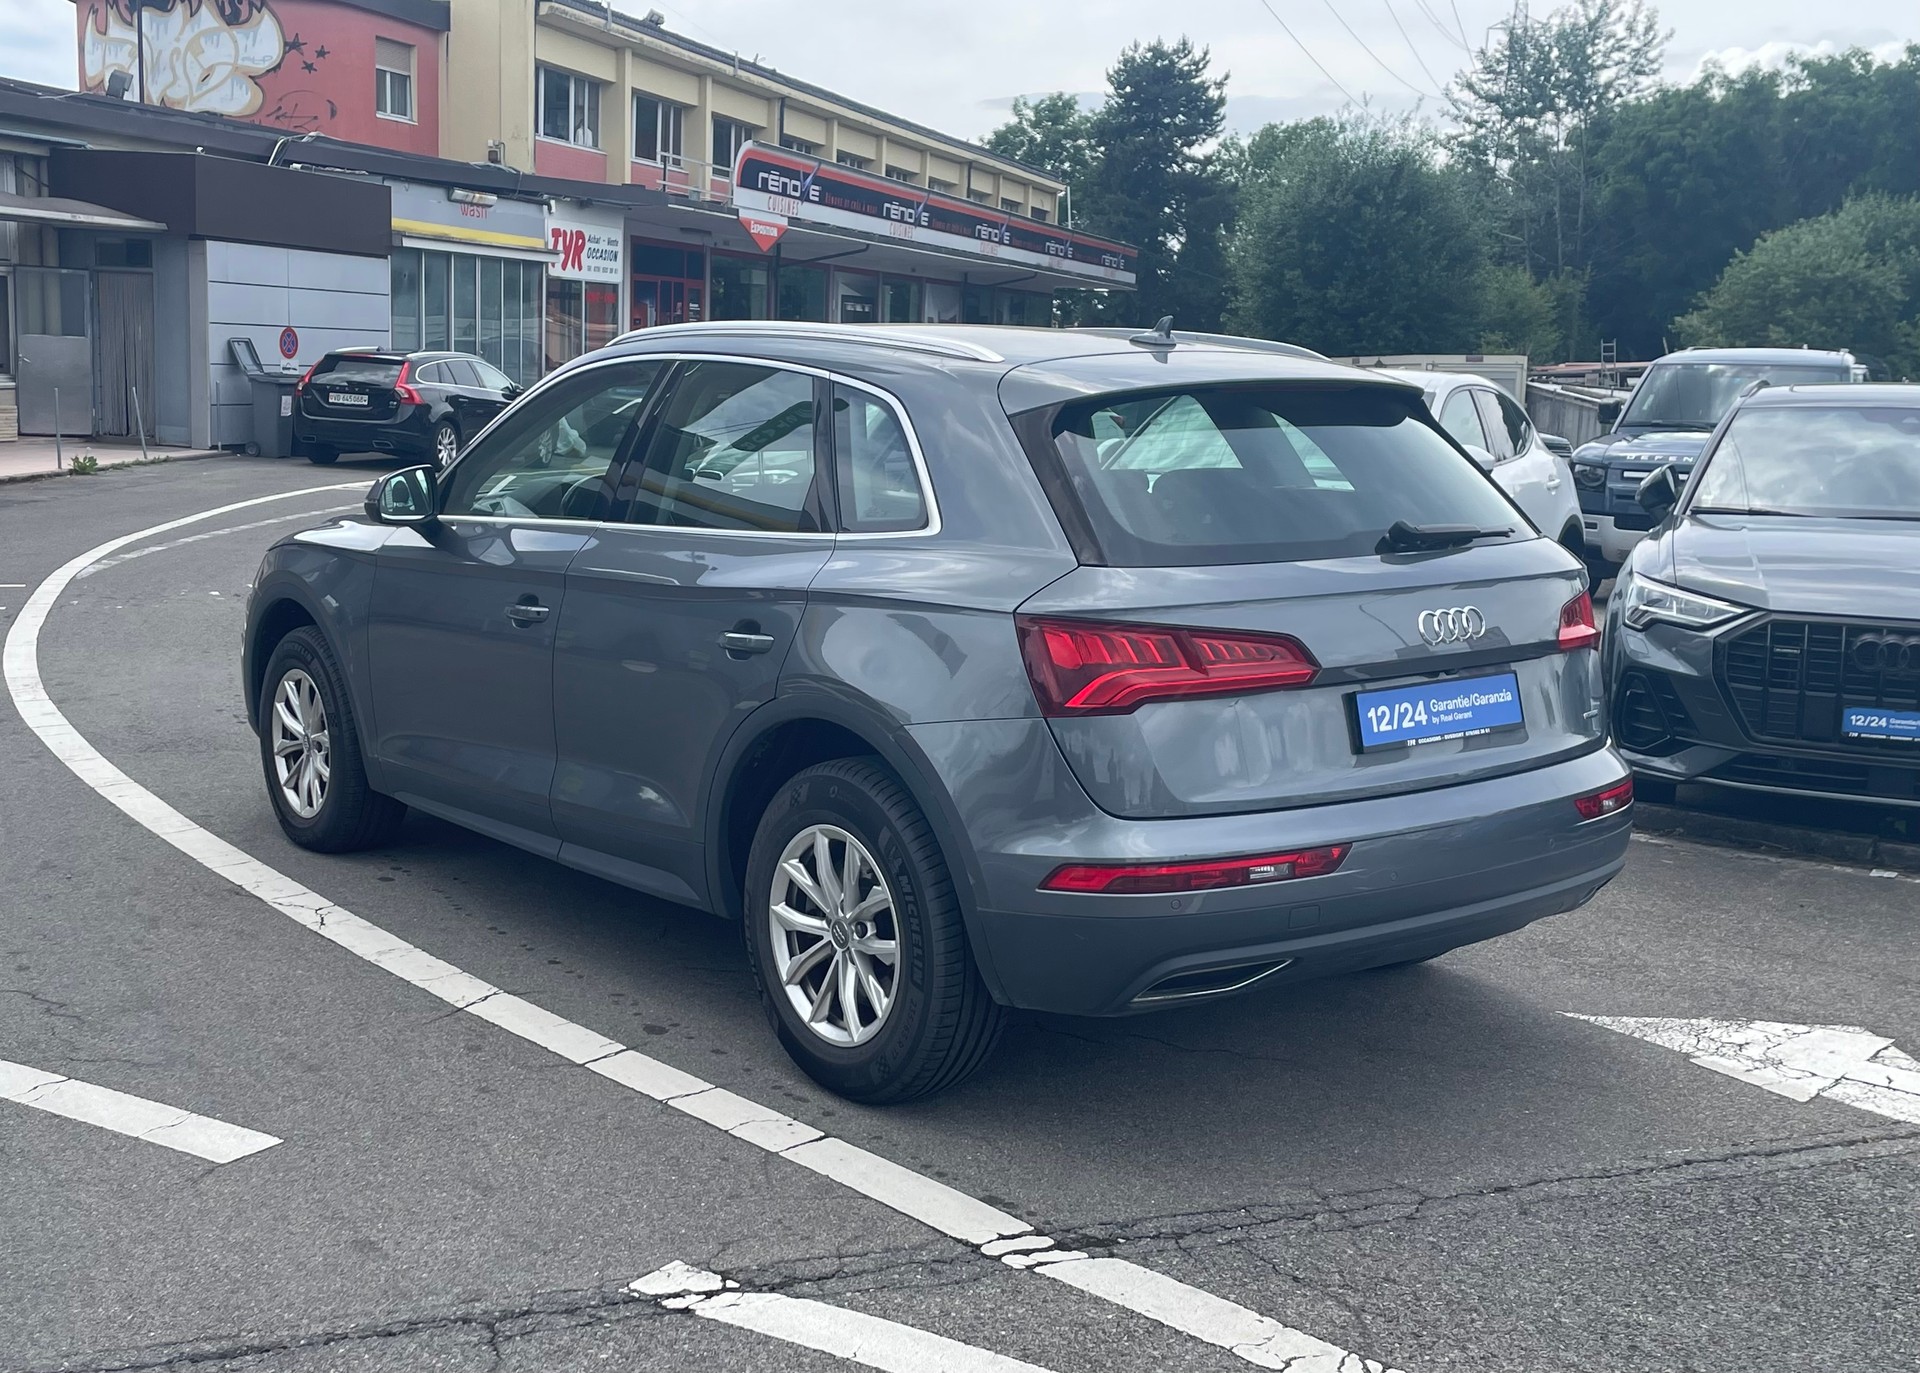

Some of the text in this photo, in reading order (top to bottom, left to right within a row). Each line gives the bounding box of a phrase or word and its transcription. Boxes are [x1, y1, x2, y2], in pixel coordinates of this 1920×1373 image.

[551, 228, 586, 272] TYR
[586, 247, 619, 262] OCCASION
[1626, 455, 1693, 463] DEFEN
[1430, 689, 1512, 712] Garantie/Garanzia
[1367, 700, 1428, 733] 12/24
[1432, 711, 1473, 725] by Real Garant
[1850, 714, 1887, 728] 12/24
[898, 875, 923, 986] MICHELIN
